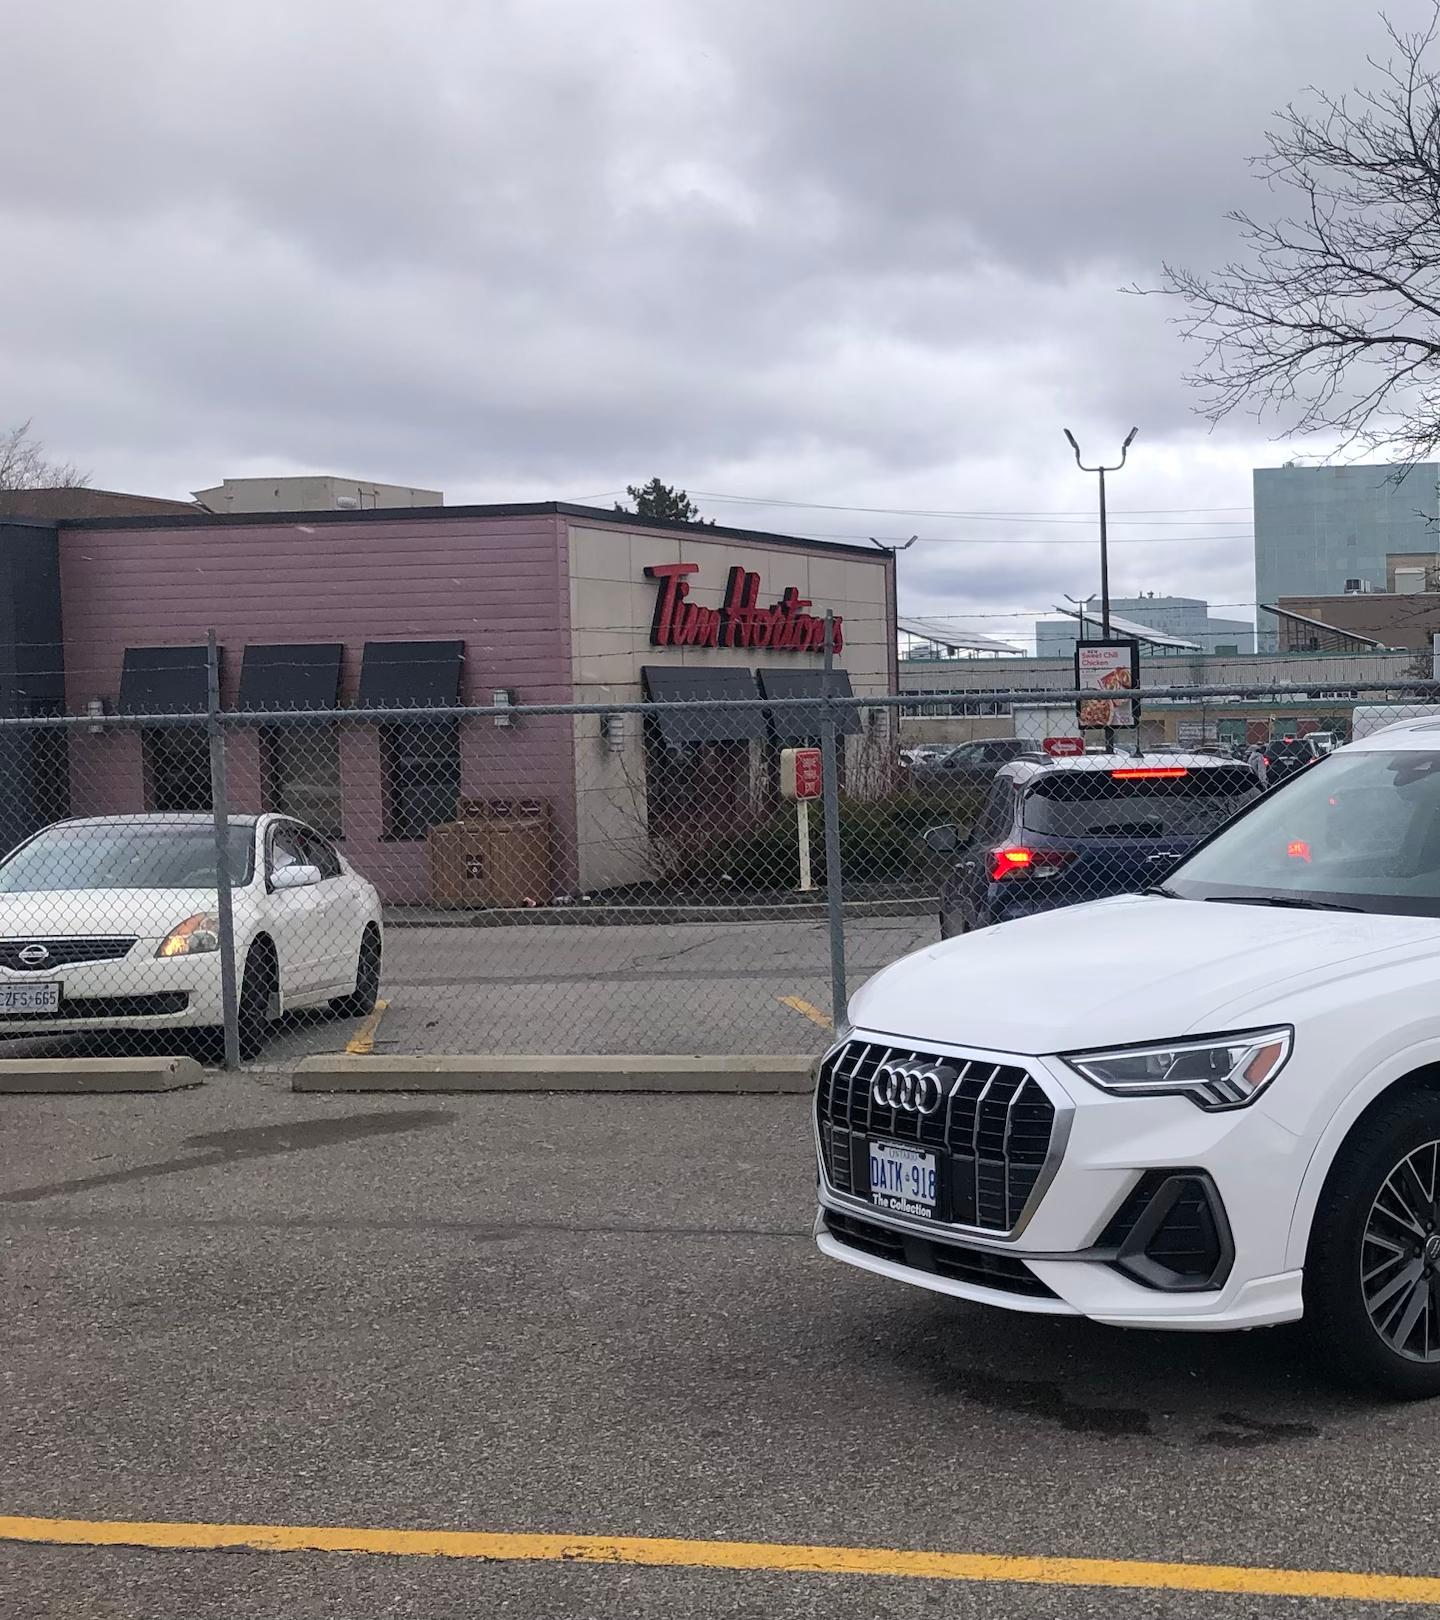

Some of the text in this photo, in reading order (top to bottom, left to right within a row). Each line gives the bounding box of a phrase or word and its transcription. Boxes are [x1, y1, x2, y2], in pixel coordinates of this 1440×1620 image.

[644, 563, 843, 654] Tim Hortons
[1081, 651, 1102, 659] Sweet
[35, 992, 56, 1005] 665
[871, 1156, 936, 1200] DATK 918
[872, 1193, 932, 1218] The Collection
